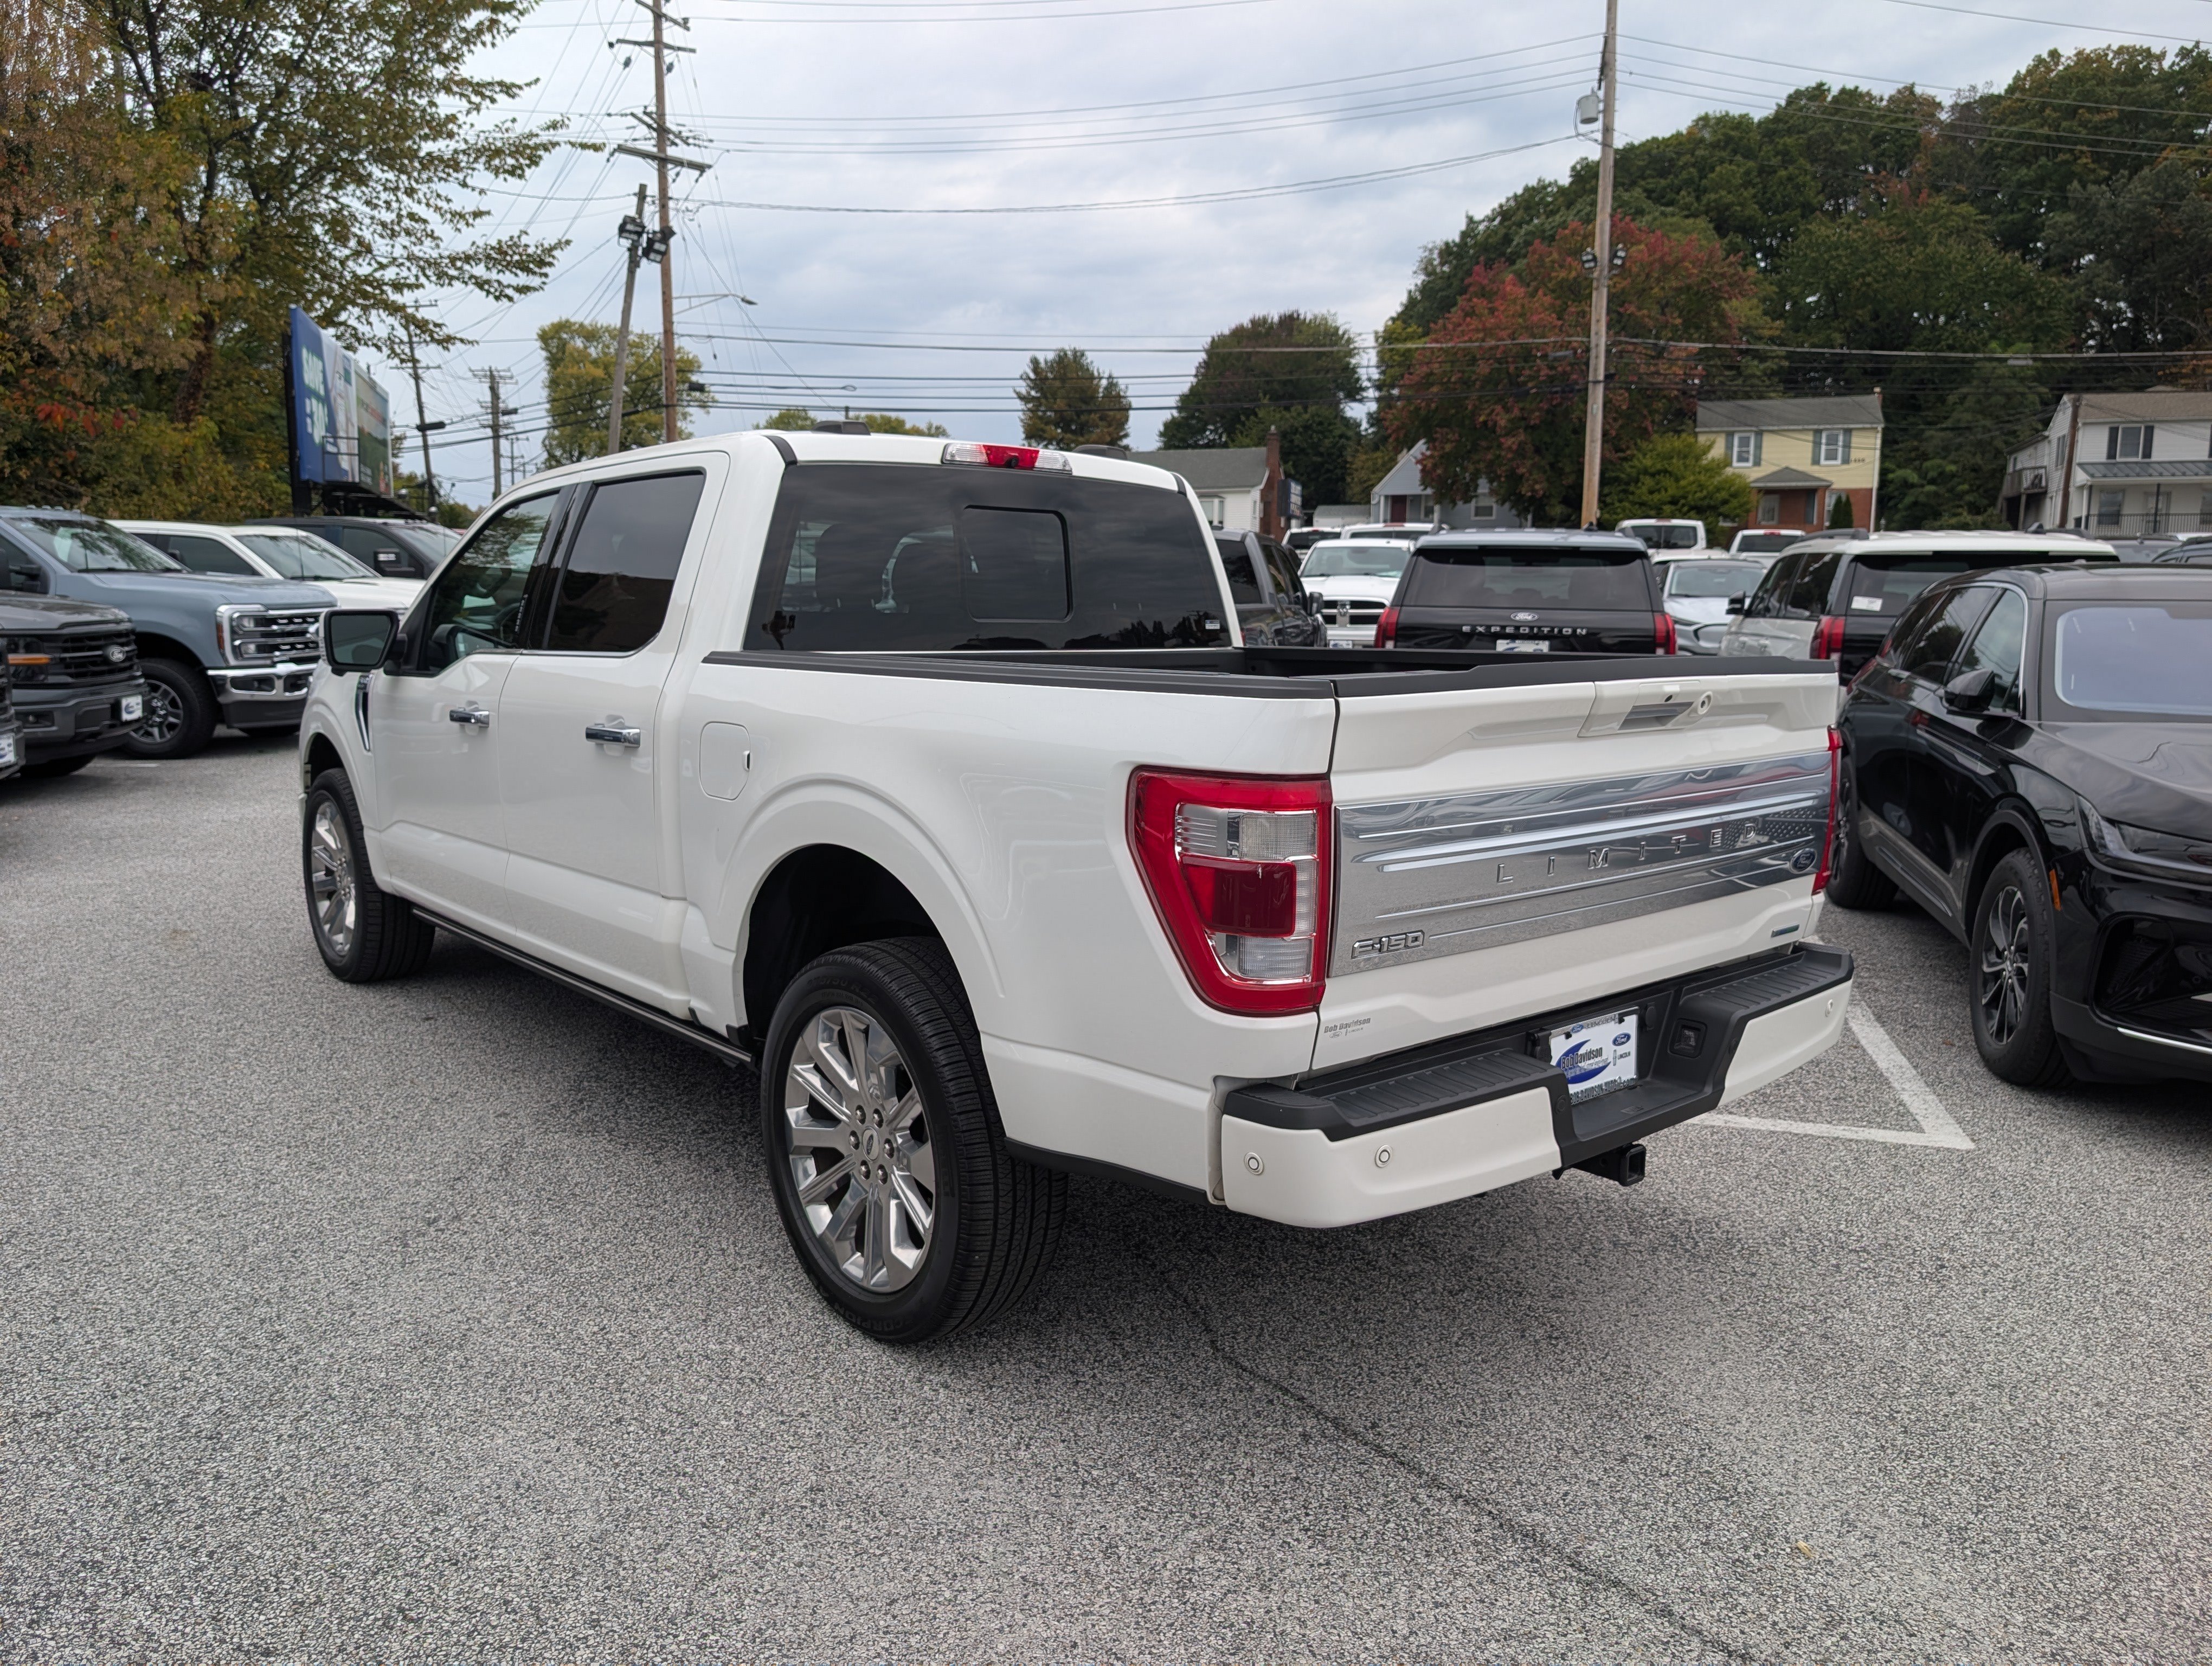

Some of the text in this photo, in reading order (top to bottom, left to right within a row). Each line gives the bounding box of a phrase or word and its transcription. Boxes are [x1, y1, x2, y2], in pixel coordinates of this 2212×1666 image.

[1462, 625, 1588, 635] EXPEDITION
[1496, 823, 1756, 884] LIMITED
[1351, 930, 1425, 959] F-150
[1324, 1018, 1371, 1033] Bob Davidson
[1613, 1034, 1629, 1045] Ford
[1561, 1054, 1574, 1069] Bob
[1574, 1046, 1603, 1065] Davidson
